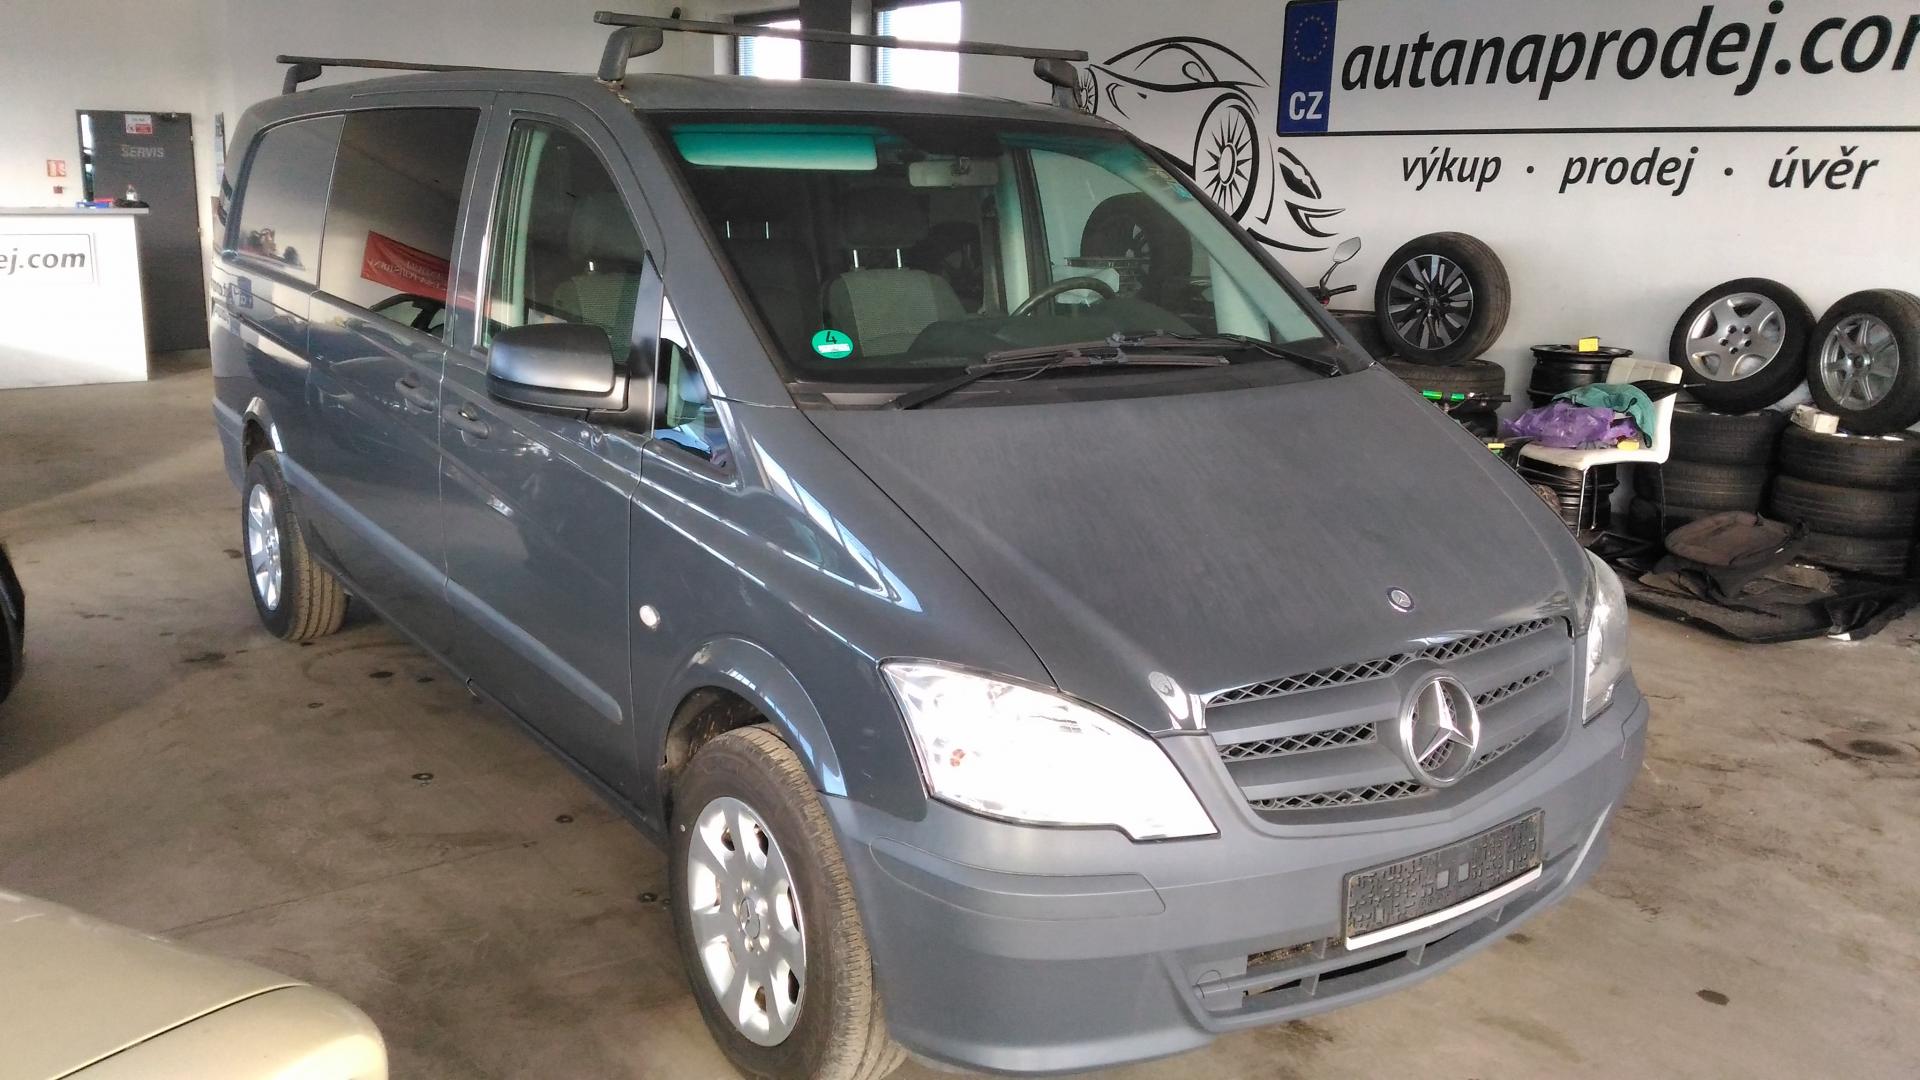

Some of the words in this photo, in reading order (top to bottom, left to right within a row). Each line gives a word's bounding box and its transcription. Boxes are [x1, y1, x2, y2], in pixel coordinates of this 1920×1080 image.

[1288, 91, 1324, 121] CZ
[120, 146, 165, 158] SERVIS
[1402, 146, 1502, 192] výkup
[1558, 146, 1699, 197] prodej
[1768, 145, 1880, 190] úvěr
[825, 330, 837, 345] 4
